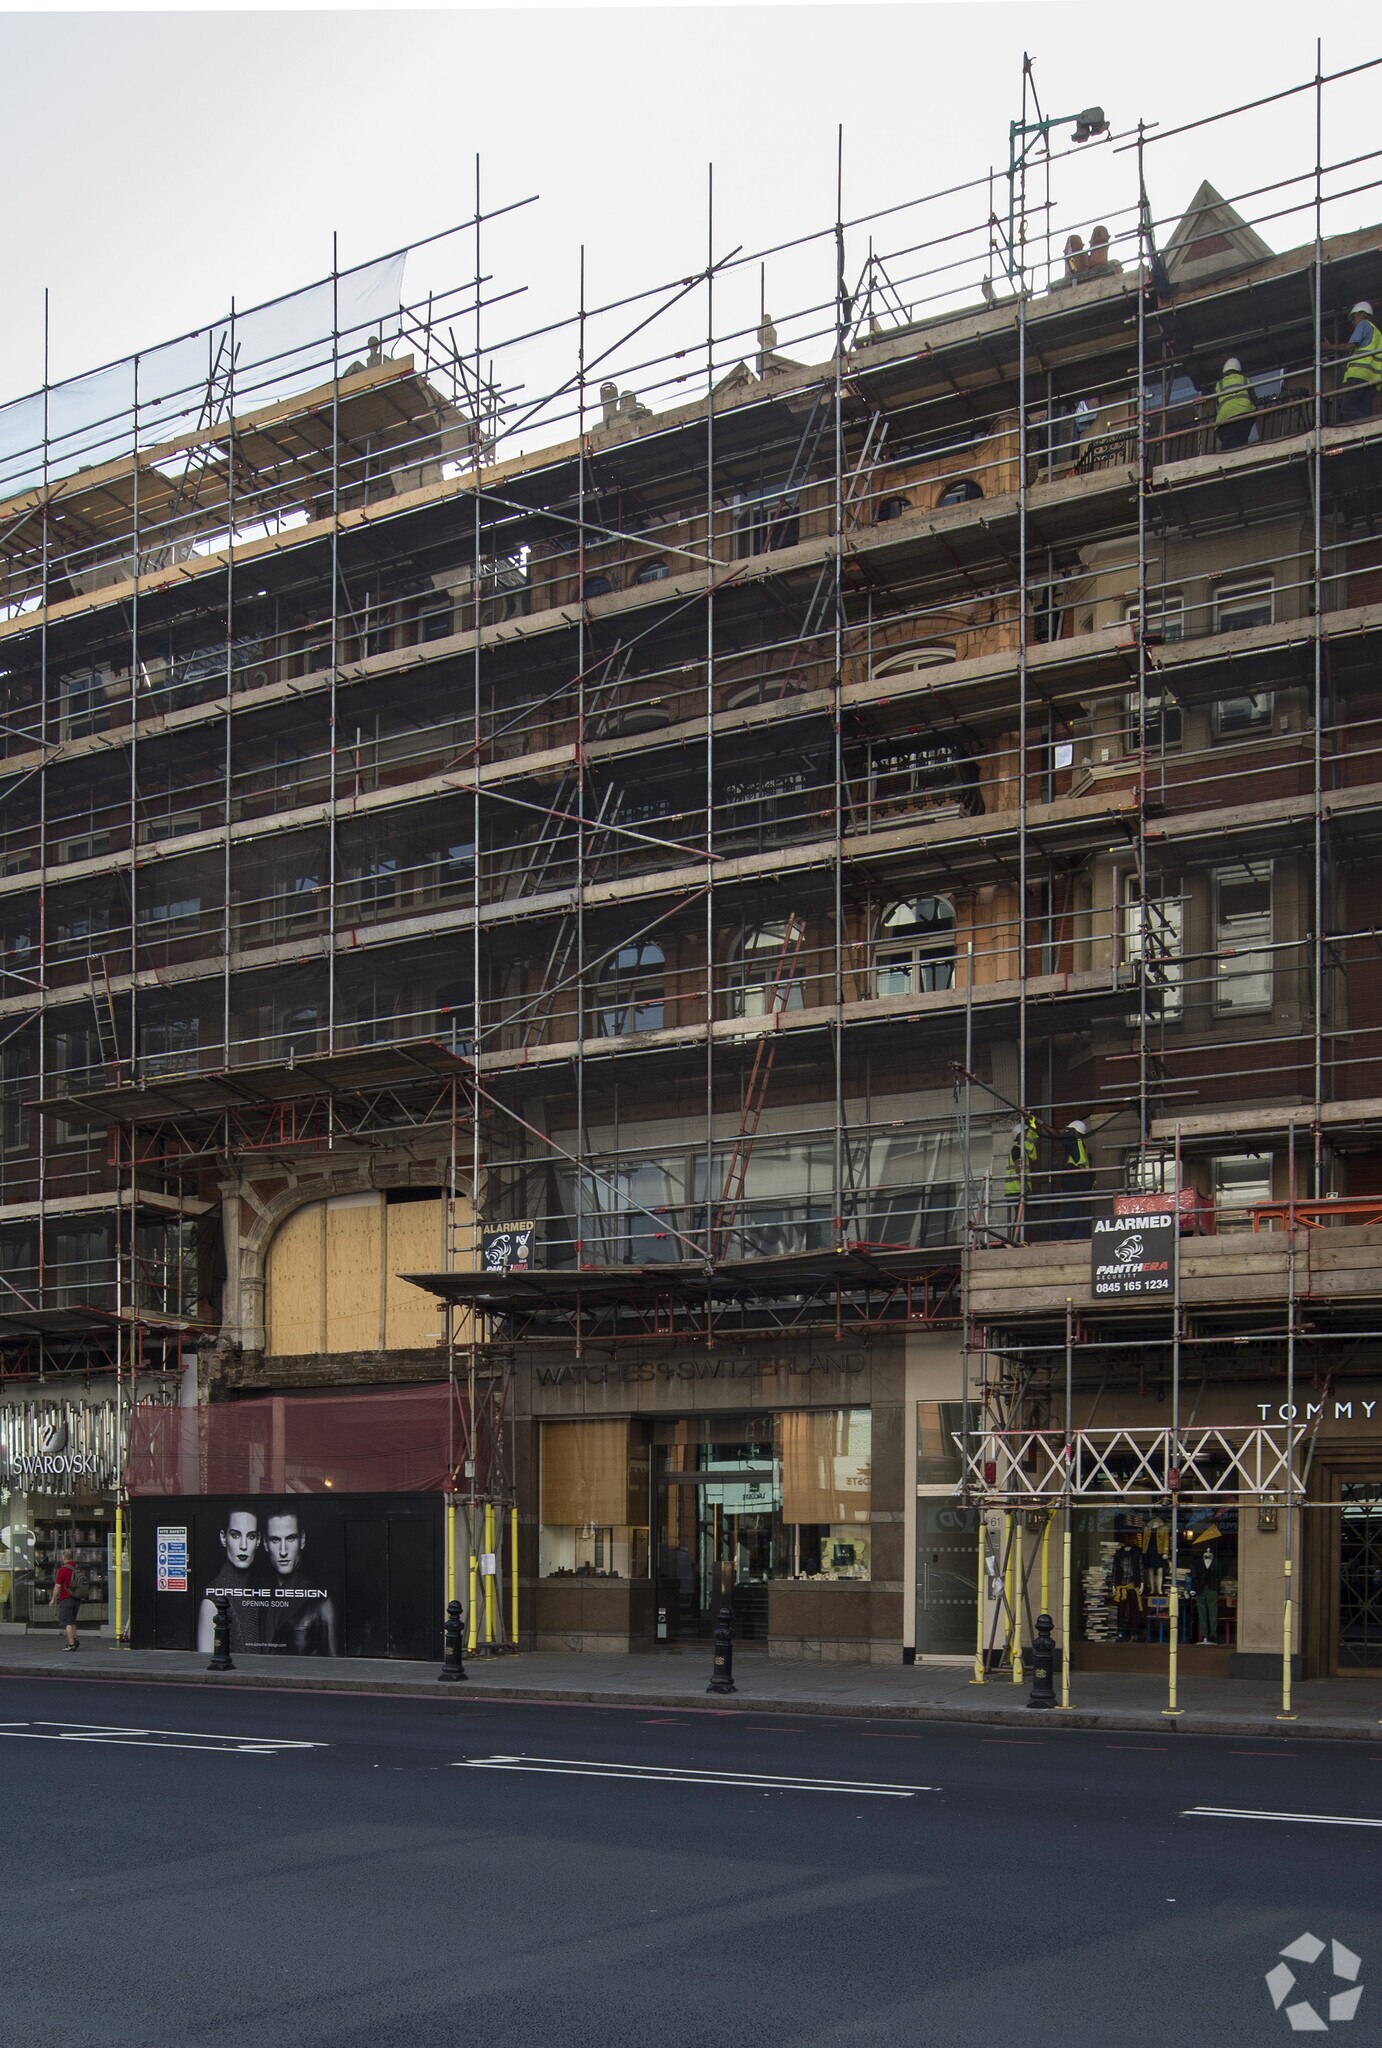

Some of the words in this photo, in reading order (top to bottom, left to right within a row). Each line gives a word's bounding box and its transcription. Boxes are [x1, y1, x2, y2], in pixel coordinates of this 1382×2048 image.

[483, 1221, 534, 1234] ALARMED
[1094, 1215, 1172, 1233] ALARMED
[1096, 1261, 1168, 1275] PANTHERA
[1096, 1282, 1121, 1293] 0845
[1124, 1281, 1142, 1291] 165
[1144, 1279, 1169, 1290] 1234
[536, 1362, 655, 1387] WATCHES
[677, 1353, 865, 1381] SWITZERLAND
[1257, 1401, 1377, 1421] TOMMY
[13, 1455, 98, 1474] SWAROVSKI
[205, 1588, 271, 1597] PORSCHE
[274, 1589, 328, 1598] DESIGN
